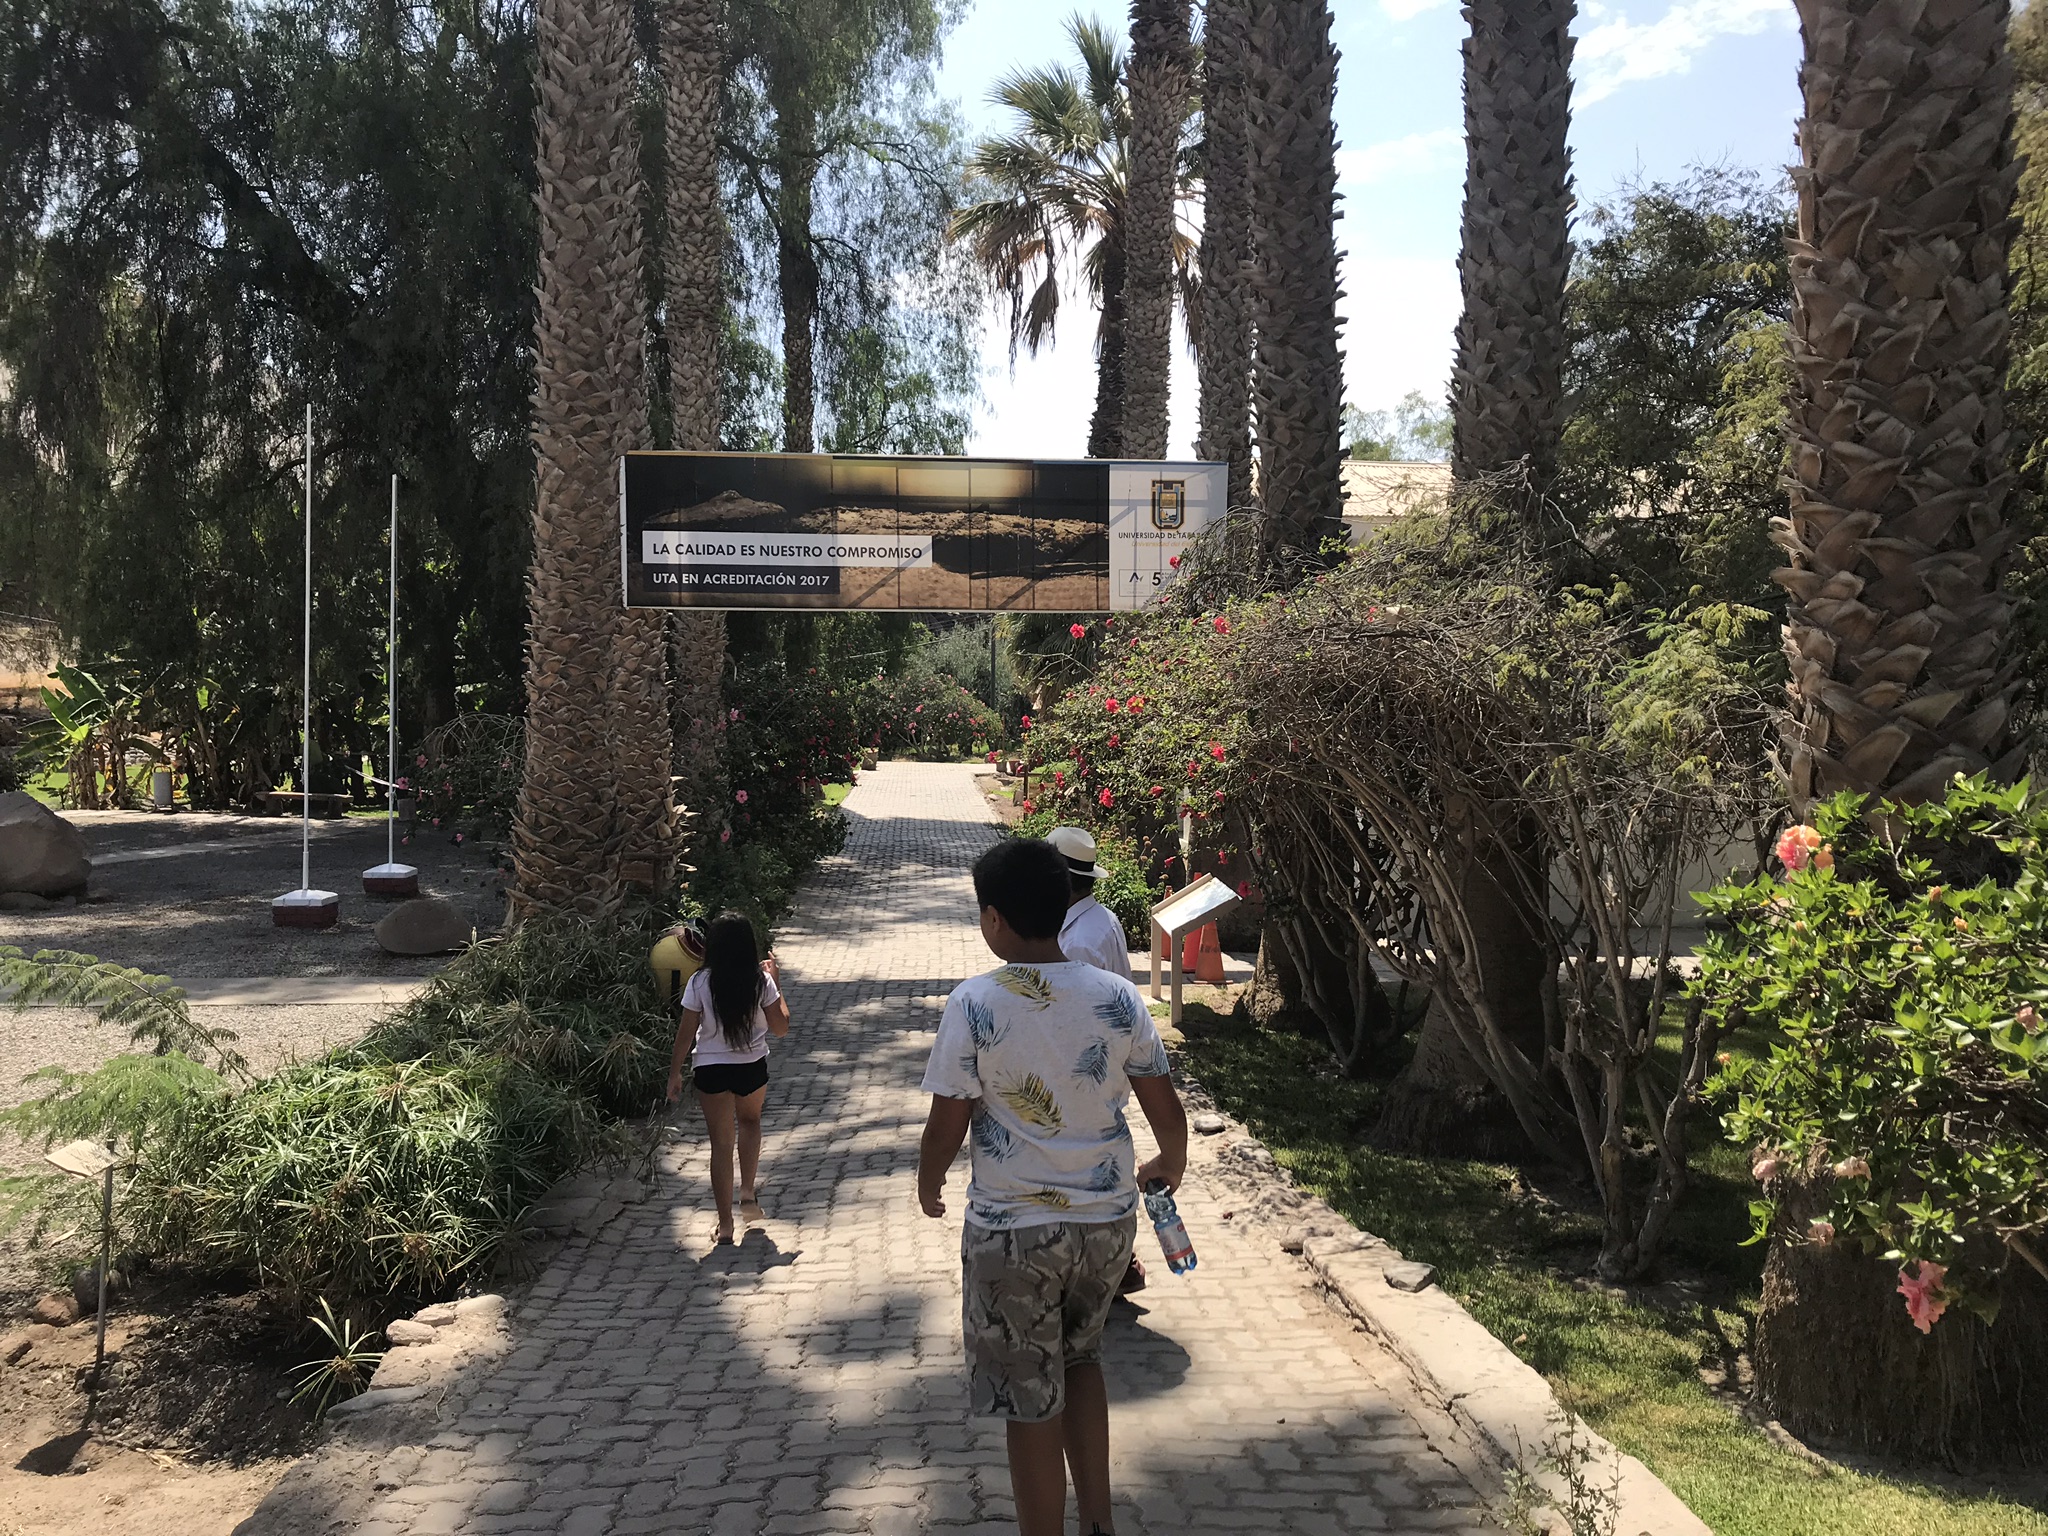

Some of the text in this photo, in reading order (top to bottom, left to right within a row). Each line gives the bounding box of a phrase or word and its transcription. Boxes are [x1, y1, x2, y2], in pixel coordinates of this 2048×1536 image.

[653, 543, 923, 559] LA CALIDAD ES NUESTRO COMPROMISO
[653, 572, 830, 586] UTA EN ACREDITACIÓN 2017
[1152, 571, 1161, 586] 5
